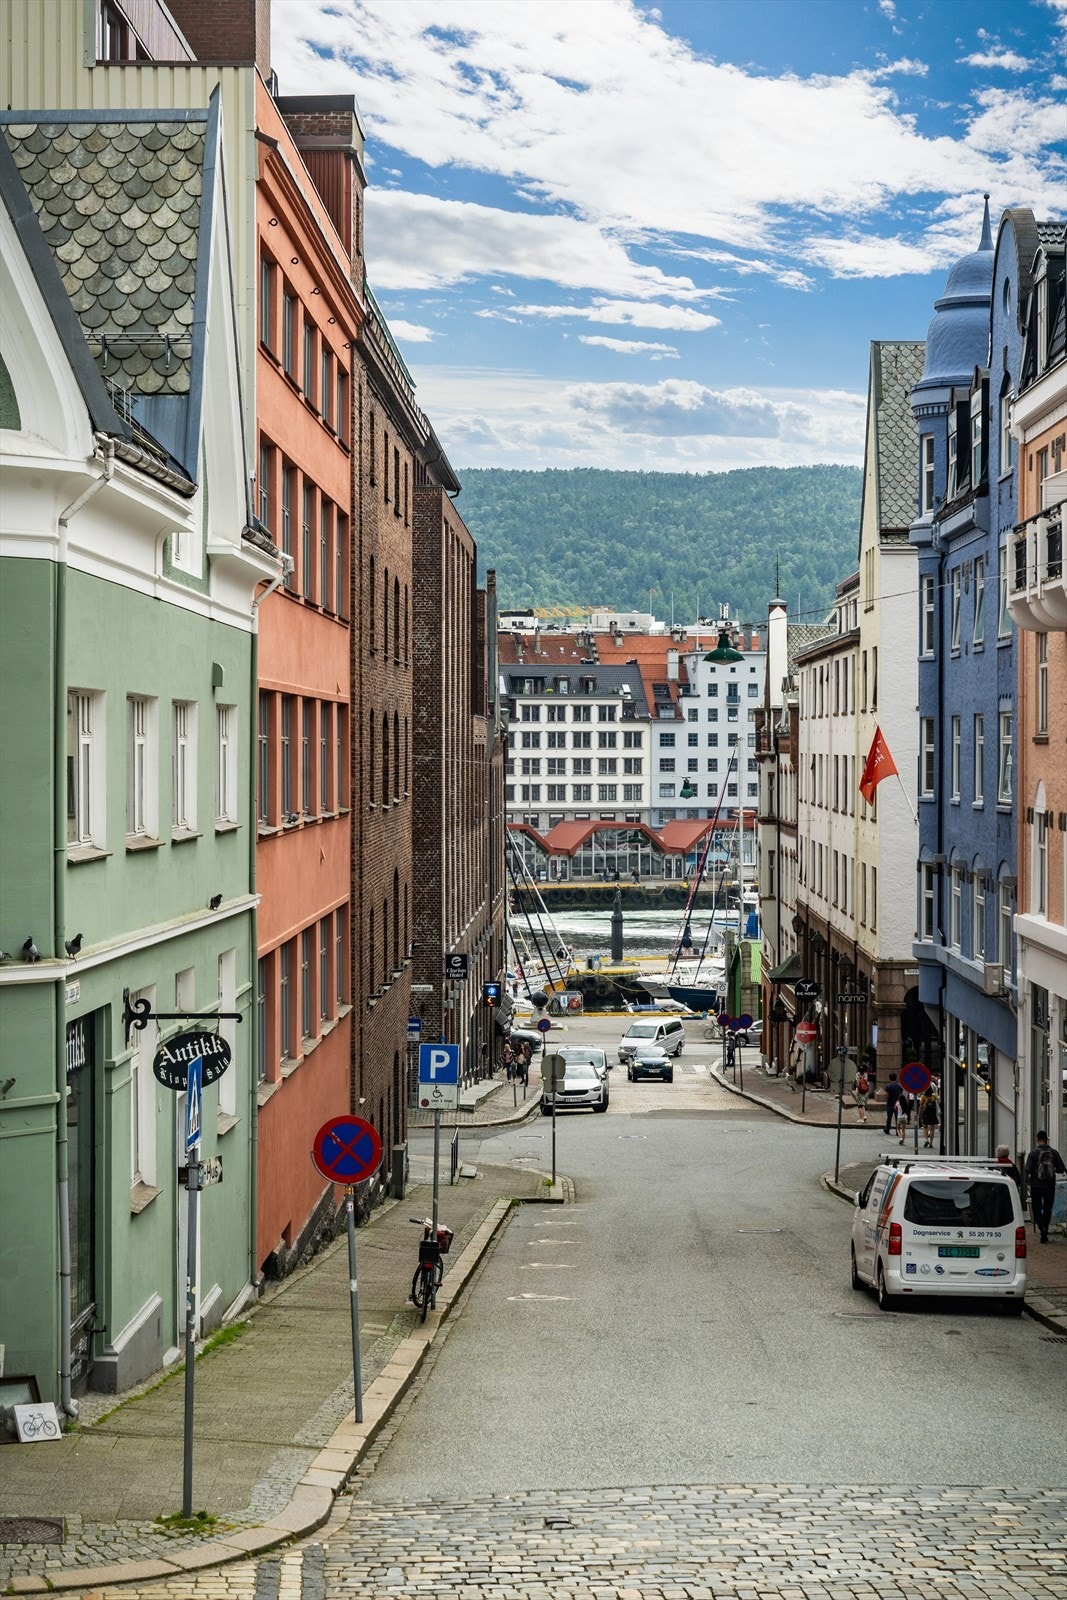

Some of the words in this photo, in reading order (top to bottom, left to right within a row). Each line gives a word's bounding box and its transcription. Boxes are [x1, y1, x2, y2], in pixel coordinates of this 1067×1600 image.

[160, 1035, 223, 1066] Antikk
[430, 1050, 450, 1079] P
[912, 1229, 951, 1237] Døgnservice
